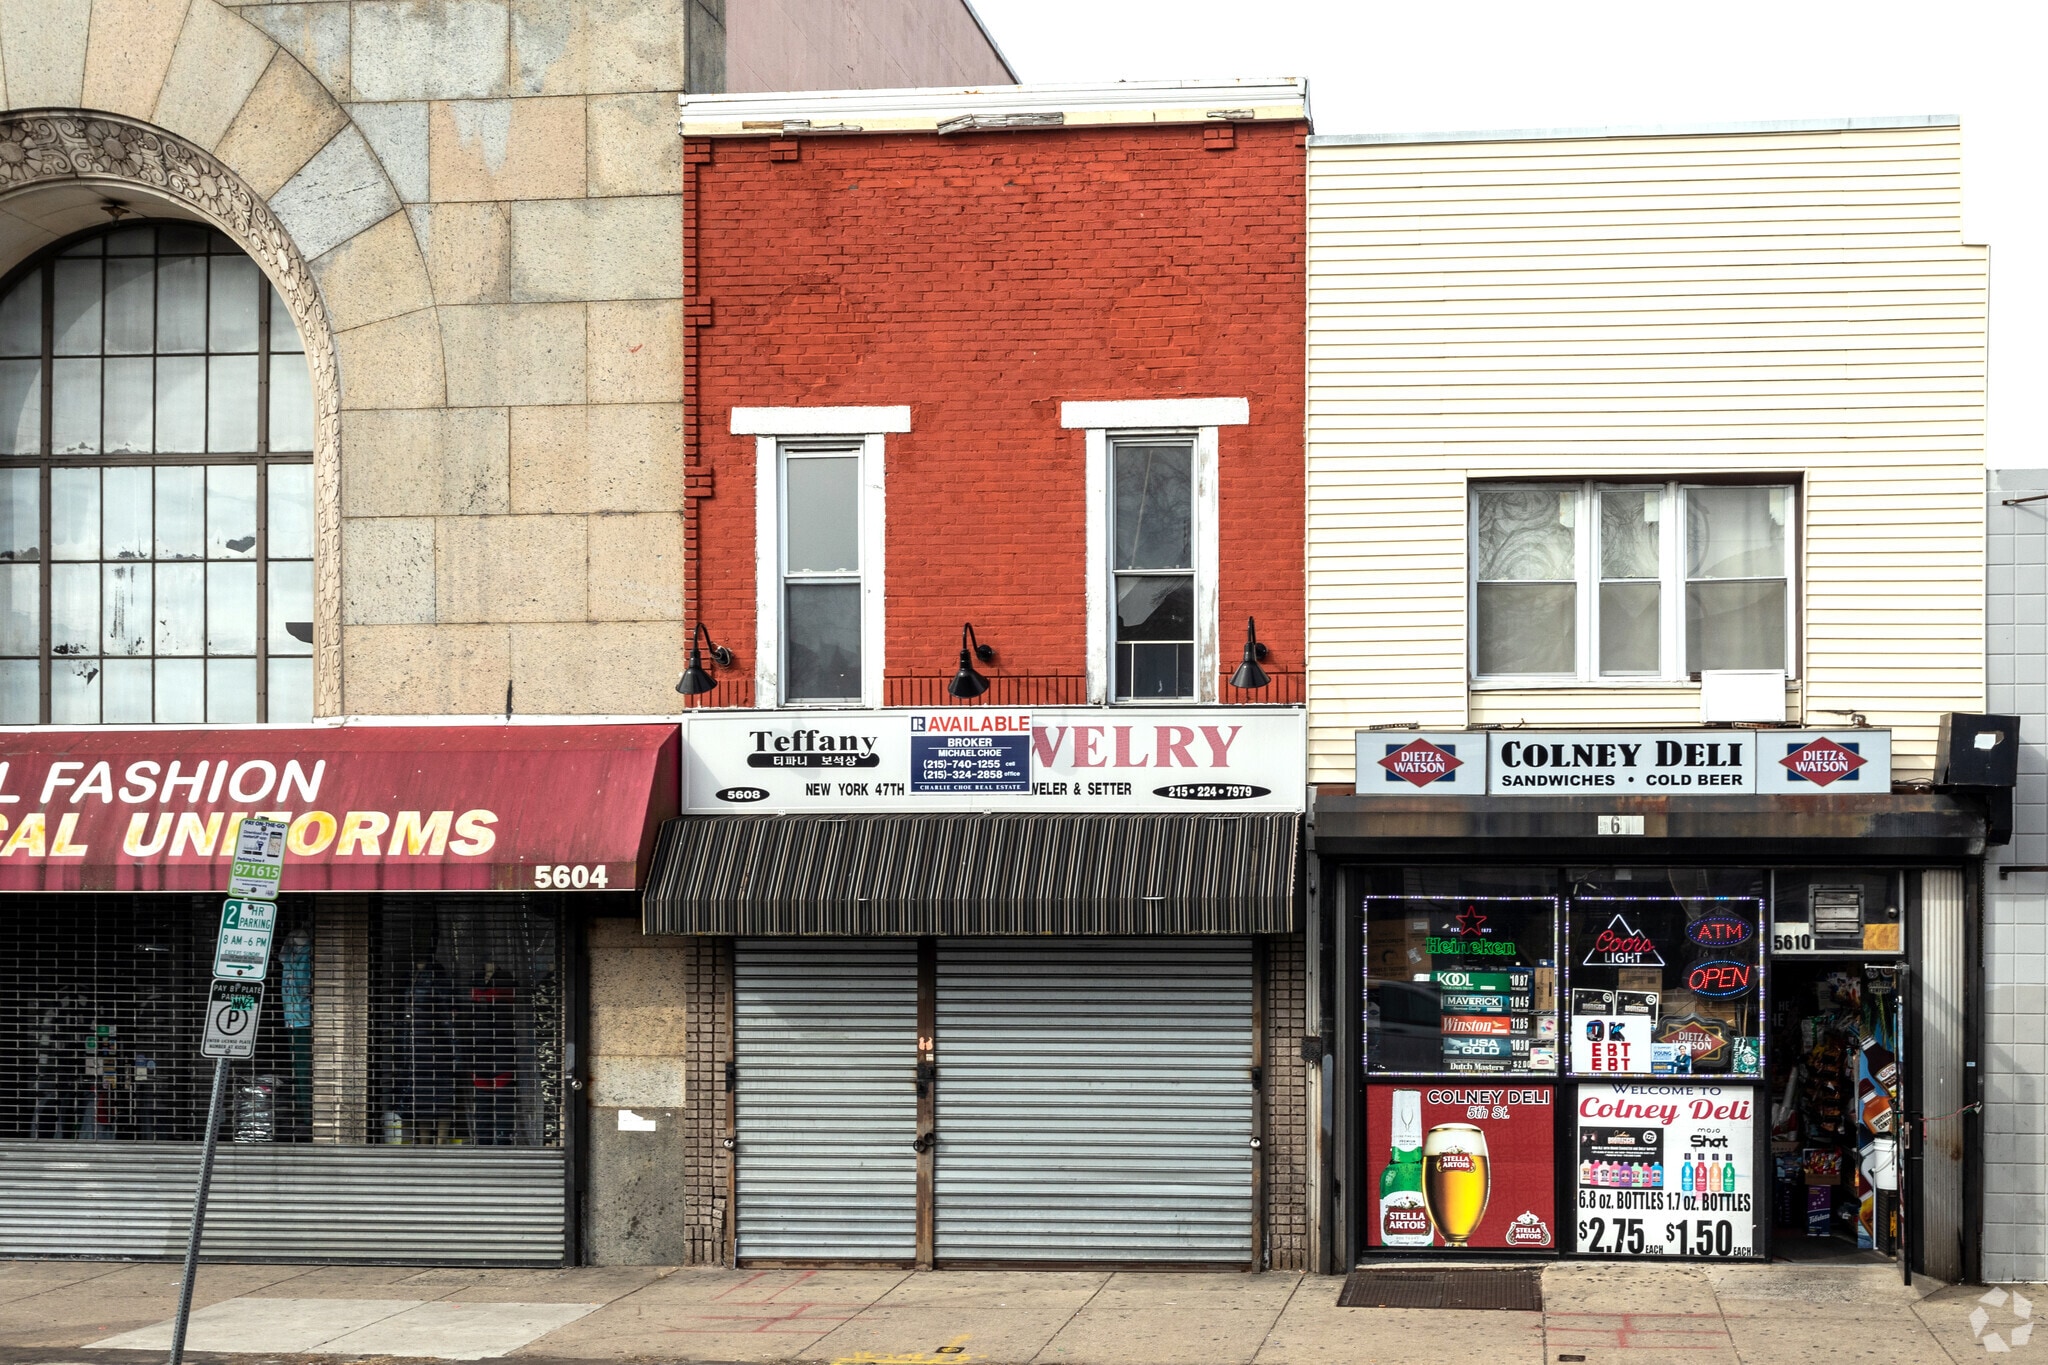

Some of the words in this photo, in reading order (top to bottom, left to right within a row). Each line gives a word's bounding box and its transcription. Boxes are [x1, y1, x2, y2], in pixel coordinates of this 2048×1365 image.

[928, 716, 1030, 732] AVAILABLE
[750, 730, 878, 757] Teffany
[947, 738, 993, 747] BROKER
[1032, 726, 1243, 768] WELRY
[938, 749, 976, 757] MICHAEL
[977, 749, 1002, 757] CHOE
[1401, 751, 1435, 763] DIETZ
[1435, 753, 1444, 762] &
[1501, 741, 1642, 768] COLNEY
[1655, 740, 1743, 767] DELI
[1802, 750, 1837, 761] DIETZ
[1838, 751, 1847, 761] &
[773, 756, 808, 767] 티파니
[821, 755, 858, 767] 보석상
[923, 760, 1000, 769] (215)-740-1255
[1394, 762, 1446, 773] WATSON
[1795, 761, 1849, 772] WATSON
[40, 759, 326, 804] FASHION
[923, 770, 1003, 780] (215)-324-2858
[1502, 774, 1616, 787] SANDWICHES
[1646, 774, 1692, 786] COLD
[1698, 774, 1743, 786] BEER
[727, 790, 761, 800] 5608
[805, 783, 831, 796] NEW
[838, 783, 869, 796] YORK
[875, 783, 905, 796] 47TH
[1032, 782, 1067, 796] WELER
[1073, 782, 1081, 796] &
[1087, 782, 1132, 796] SETTER
[255, 820, 286, 829] ON-THE-GO
[0, 812, 88, 857] AL
[122, 809, 499, 858] UNIORMS
[235, 863, 279, 878] 971615
[534, 865, 609, 889] 5604
[226, 905, 238, 925] 2
[251, 906, 265, 917] HR
[240, 917, 271, 930] PARKING
[1697, 923, 1743, 940] ATM
[223, 934, 229, 945] 8
[255, 937, 267, 947] PM
[1425, 937, 1516, 956] Heineken
[1595, 929, 1656, 953] Coors
[1774, 933, 1811, 951] 5610
[1604, 952, 1643, 964] LIGHT
[1436, 972, 1474, 987] KOOL
[1688, 966, 1750, 990] OPEN
[241, 986, 262, 994] PLATE
[1447, 997, 1500, 1006] MAVERICK
[1443, 1017, 1492, 1033] Winston
[1586, 1019, 1626, 1042] OK
[1469, 1038, 1498, 1047] USA
[1678, 1031, 1704, 1042] DIETZ
[1705, 1033, 1712, 1042] &
[1462, 1046, 1500, 1055] GOLD
[1591, 1042, 1632, 1057] EBT
[1450, 1062, 1473, 1071] Dutch
[1475, 1062, 1505, 1072] Masters
[1591, 1057, 1631, 1071] EBT
[1612, 1083, 1694, 1096] WELCOME
[1427, 1089, 1504, 1104] COLNEY
[1507, 1089, 1550, 1105] DELI
[1466, 1105, 1489, 1119] 5th
[1491, 1105, 1511, 1119] St.
[1579, 1097, 1680, 1125] Colney
[1688, 1098, 1752, 1121] Deli
[1690, 1134, 1728, 1148] Shot
[1579, 1190, 1596, 1209] 6.8
[1599, 1193, 1614, 1209] oz.
[1617, 1191, 1664, 1210] BOTTLES
[1666, 1192, 1681, 1211] 1.7
[1683, 1195, 1699, 1211] oz.
[1702, 1193, 1751, 1212] BOTTLES
[1389, 1211, 1426, 1220] STELLA
[1389, 1220, 1426, 1230] ARTOIS
[1515, 1226, 1541, 1234] STELLA
[1645, 1244, 1664, 1254] EACH
[1733, 1246, 1752, 1257] EACH
